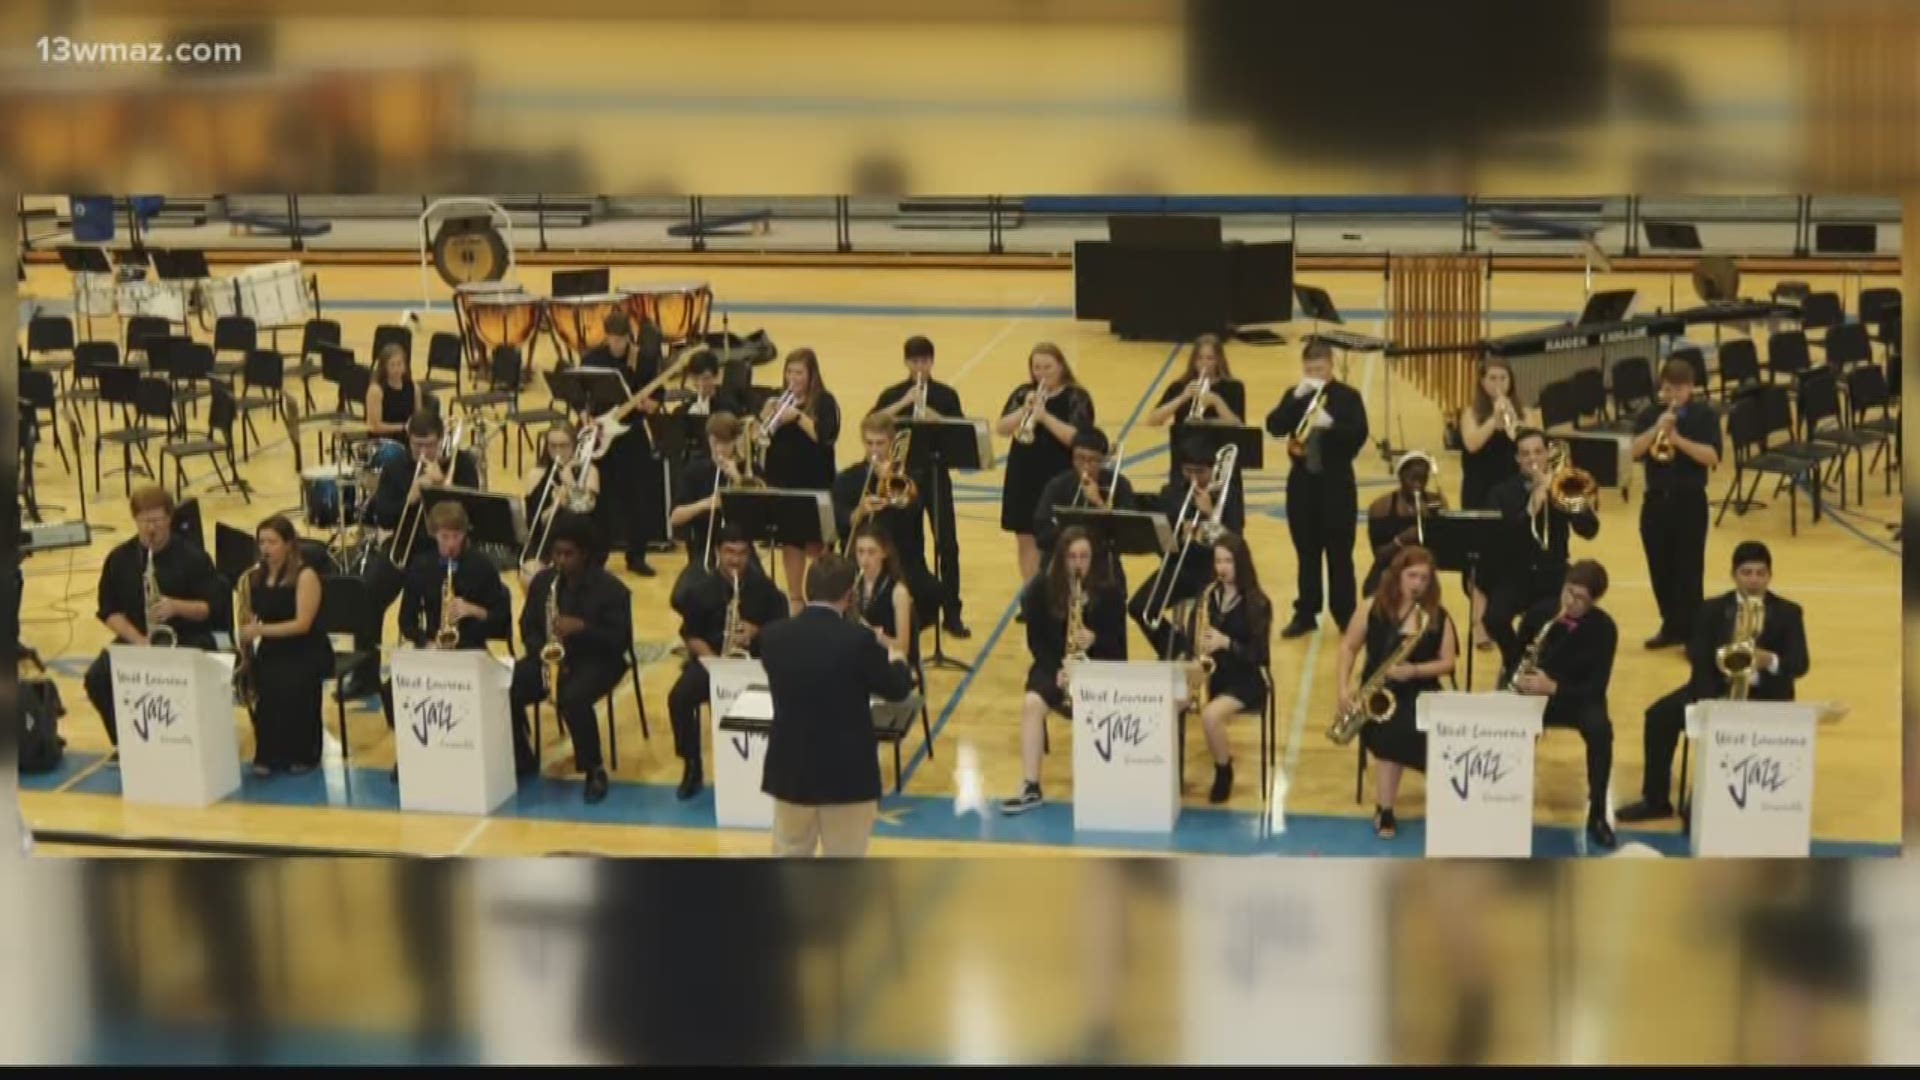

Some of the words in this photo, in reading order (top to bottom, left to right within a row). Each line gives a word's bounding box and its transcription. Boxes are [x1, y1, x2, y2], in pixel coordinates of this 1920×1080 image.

[133, 690, 178, 743] Jazz
[411, 696, 462, 747] Jazz
[1094, 710, 1150, 762] Jazz
[1450, 745, 1512, 801] Jazz
[1727, 753, 1790, 811] Jazz
